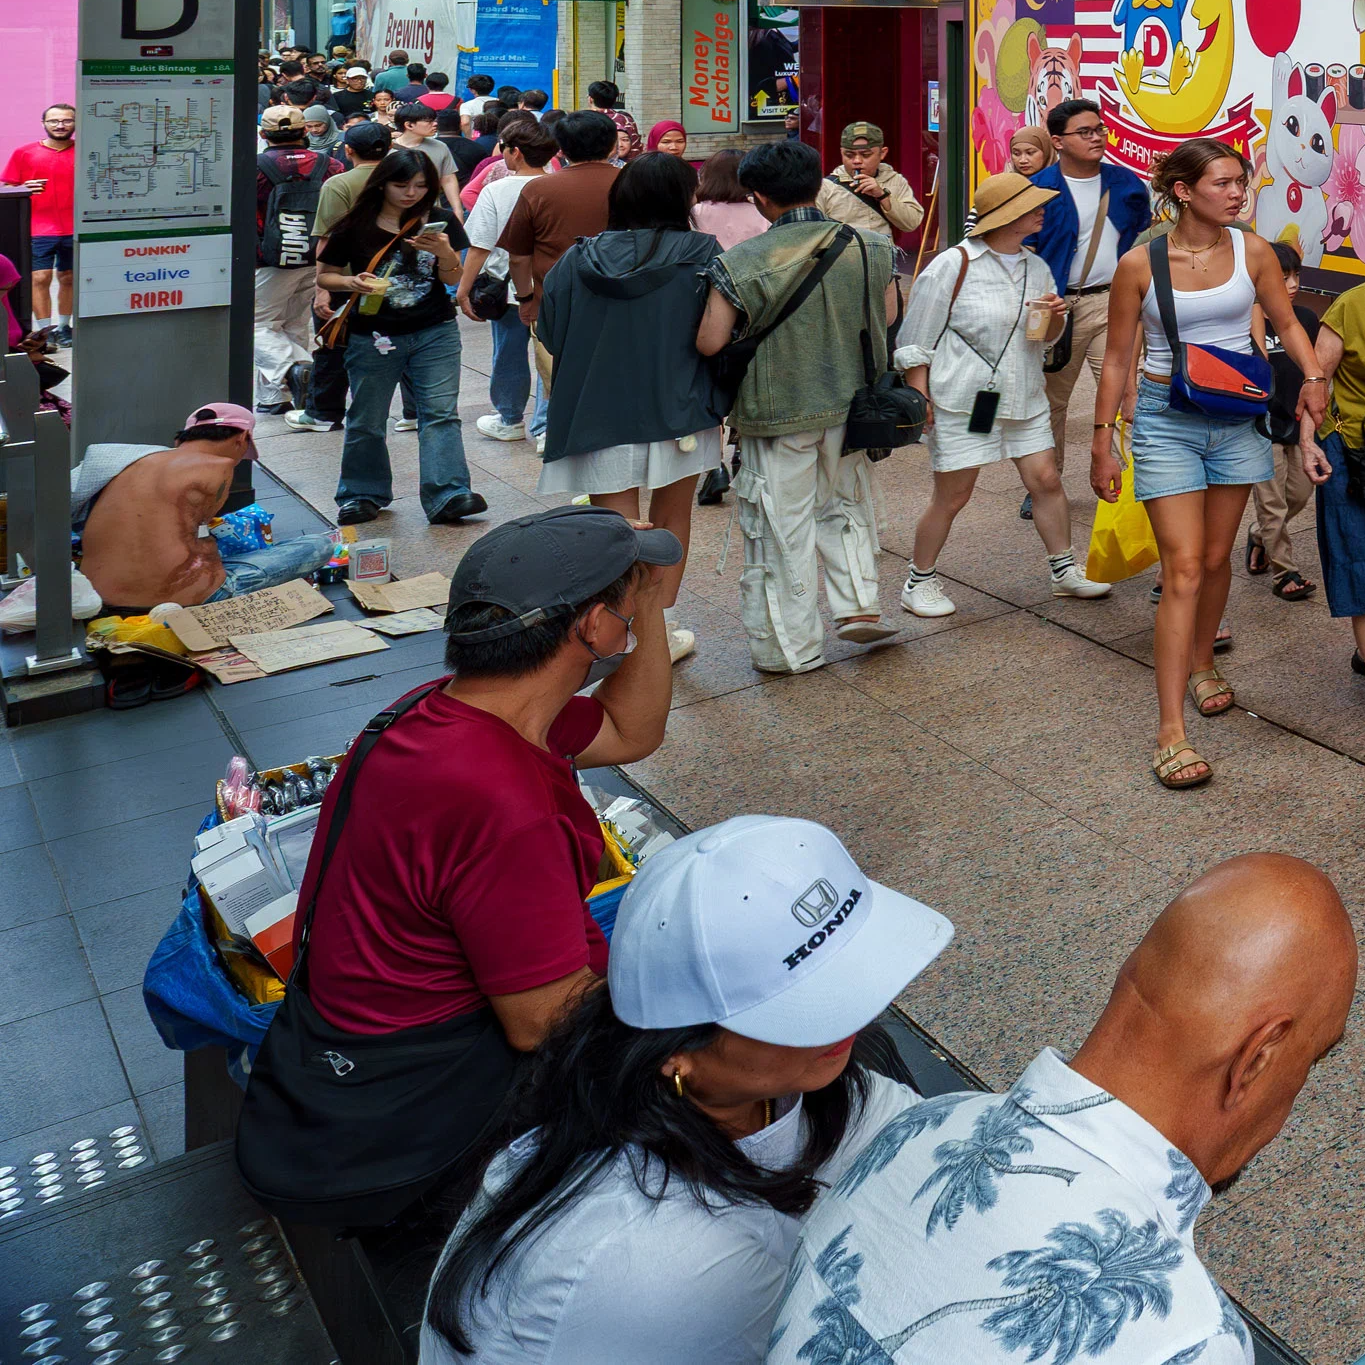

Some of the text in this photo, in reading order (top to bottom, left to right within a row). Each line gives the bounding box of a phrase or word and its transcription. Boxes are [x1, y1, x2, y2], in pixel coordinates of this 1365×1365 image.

[384, 8, 435, 65] Brewing
[129, 64, 157, 73] Bukit
[158, 64, 197, 74] Bintang
[689, 30, 713, 107] Money
[711, 12, 734, 124] Exchange
[774, 70, 799, 78] Luxury
[1119, 138, 1151, 166] JAPAN
[123, 244, 191, 258] DUNKIN'
[278, 212, 311, 266] PUMA
[124, 267, 191, 283] tealive
[129, 289, 183, 310] RORO
[782, 888, 863, 971] HONDA
